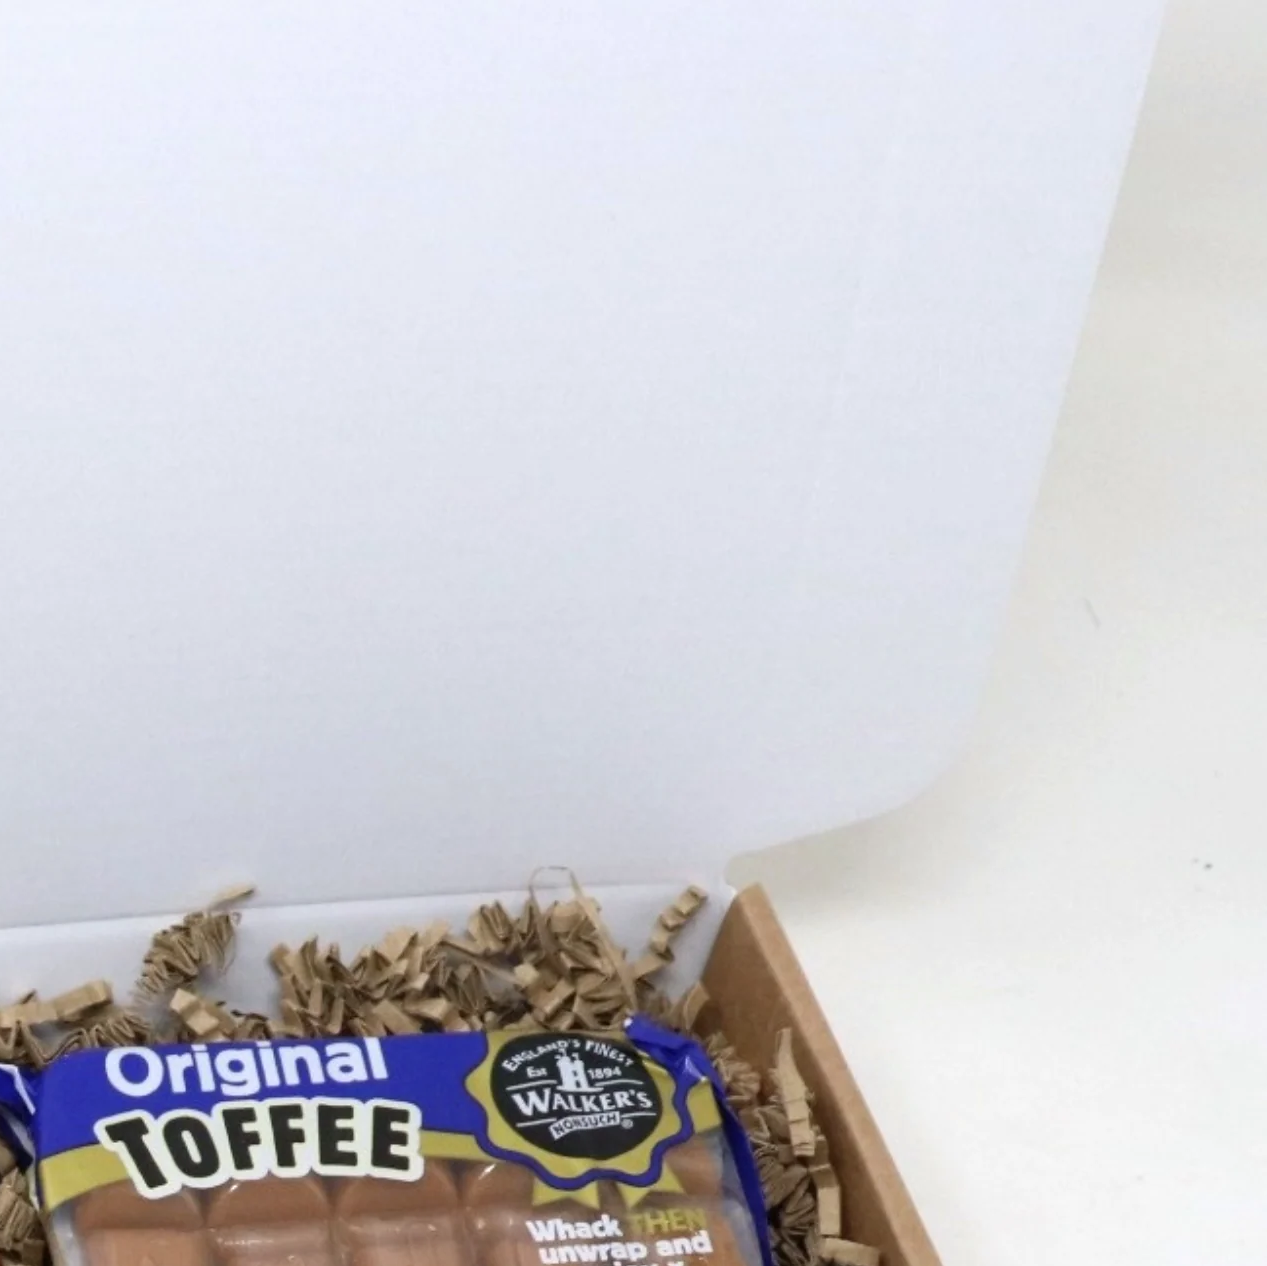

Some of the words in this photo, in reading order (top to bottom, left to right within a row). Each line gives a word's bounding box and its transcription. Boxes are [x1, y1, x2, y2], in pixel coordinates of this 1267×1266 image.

[105, 1037, 389, 1097] Original
[501, 1038, 581, 1073] ENGLAND'S
[584, 1038, 635, 1068] FINEST
[587, 1065, 622, 1080] 1894
[511, 1087, 653, 1117] WALKER'S
[552, 1113, 618, 1136] NONSUCH
[101, 1100, 414, 1191] TOFFEE
[525, 1213, 624, 1242] Whack
[634, 1207, 708, 1234] THEN
[538, 1240, 648, 1265] unwrap
[655, 1230, 714, 1257] and
